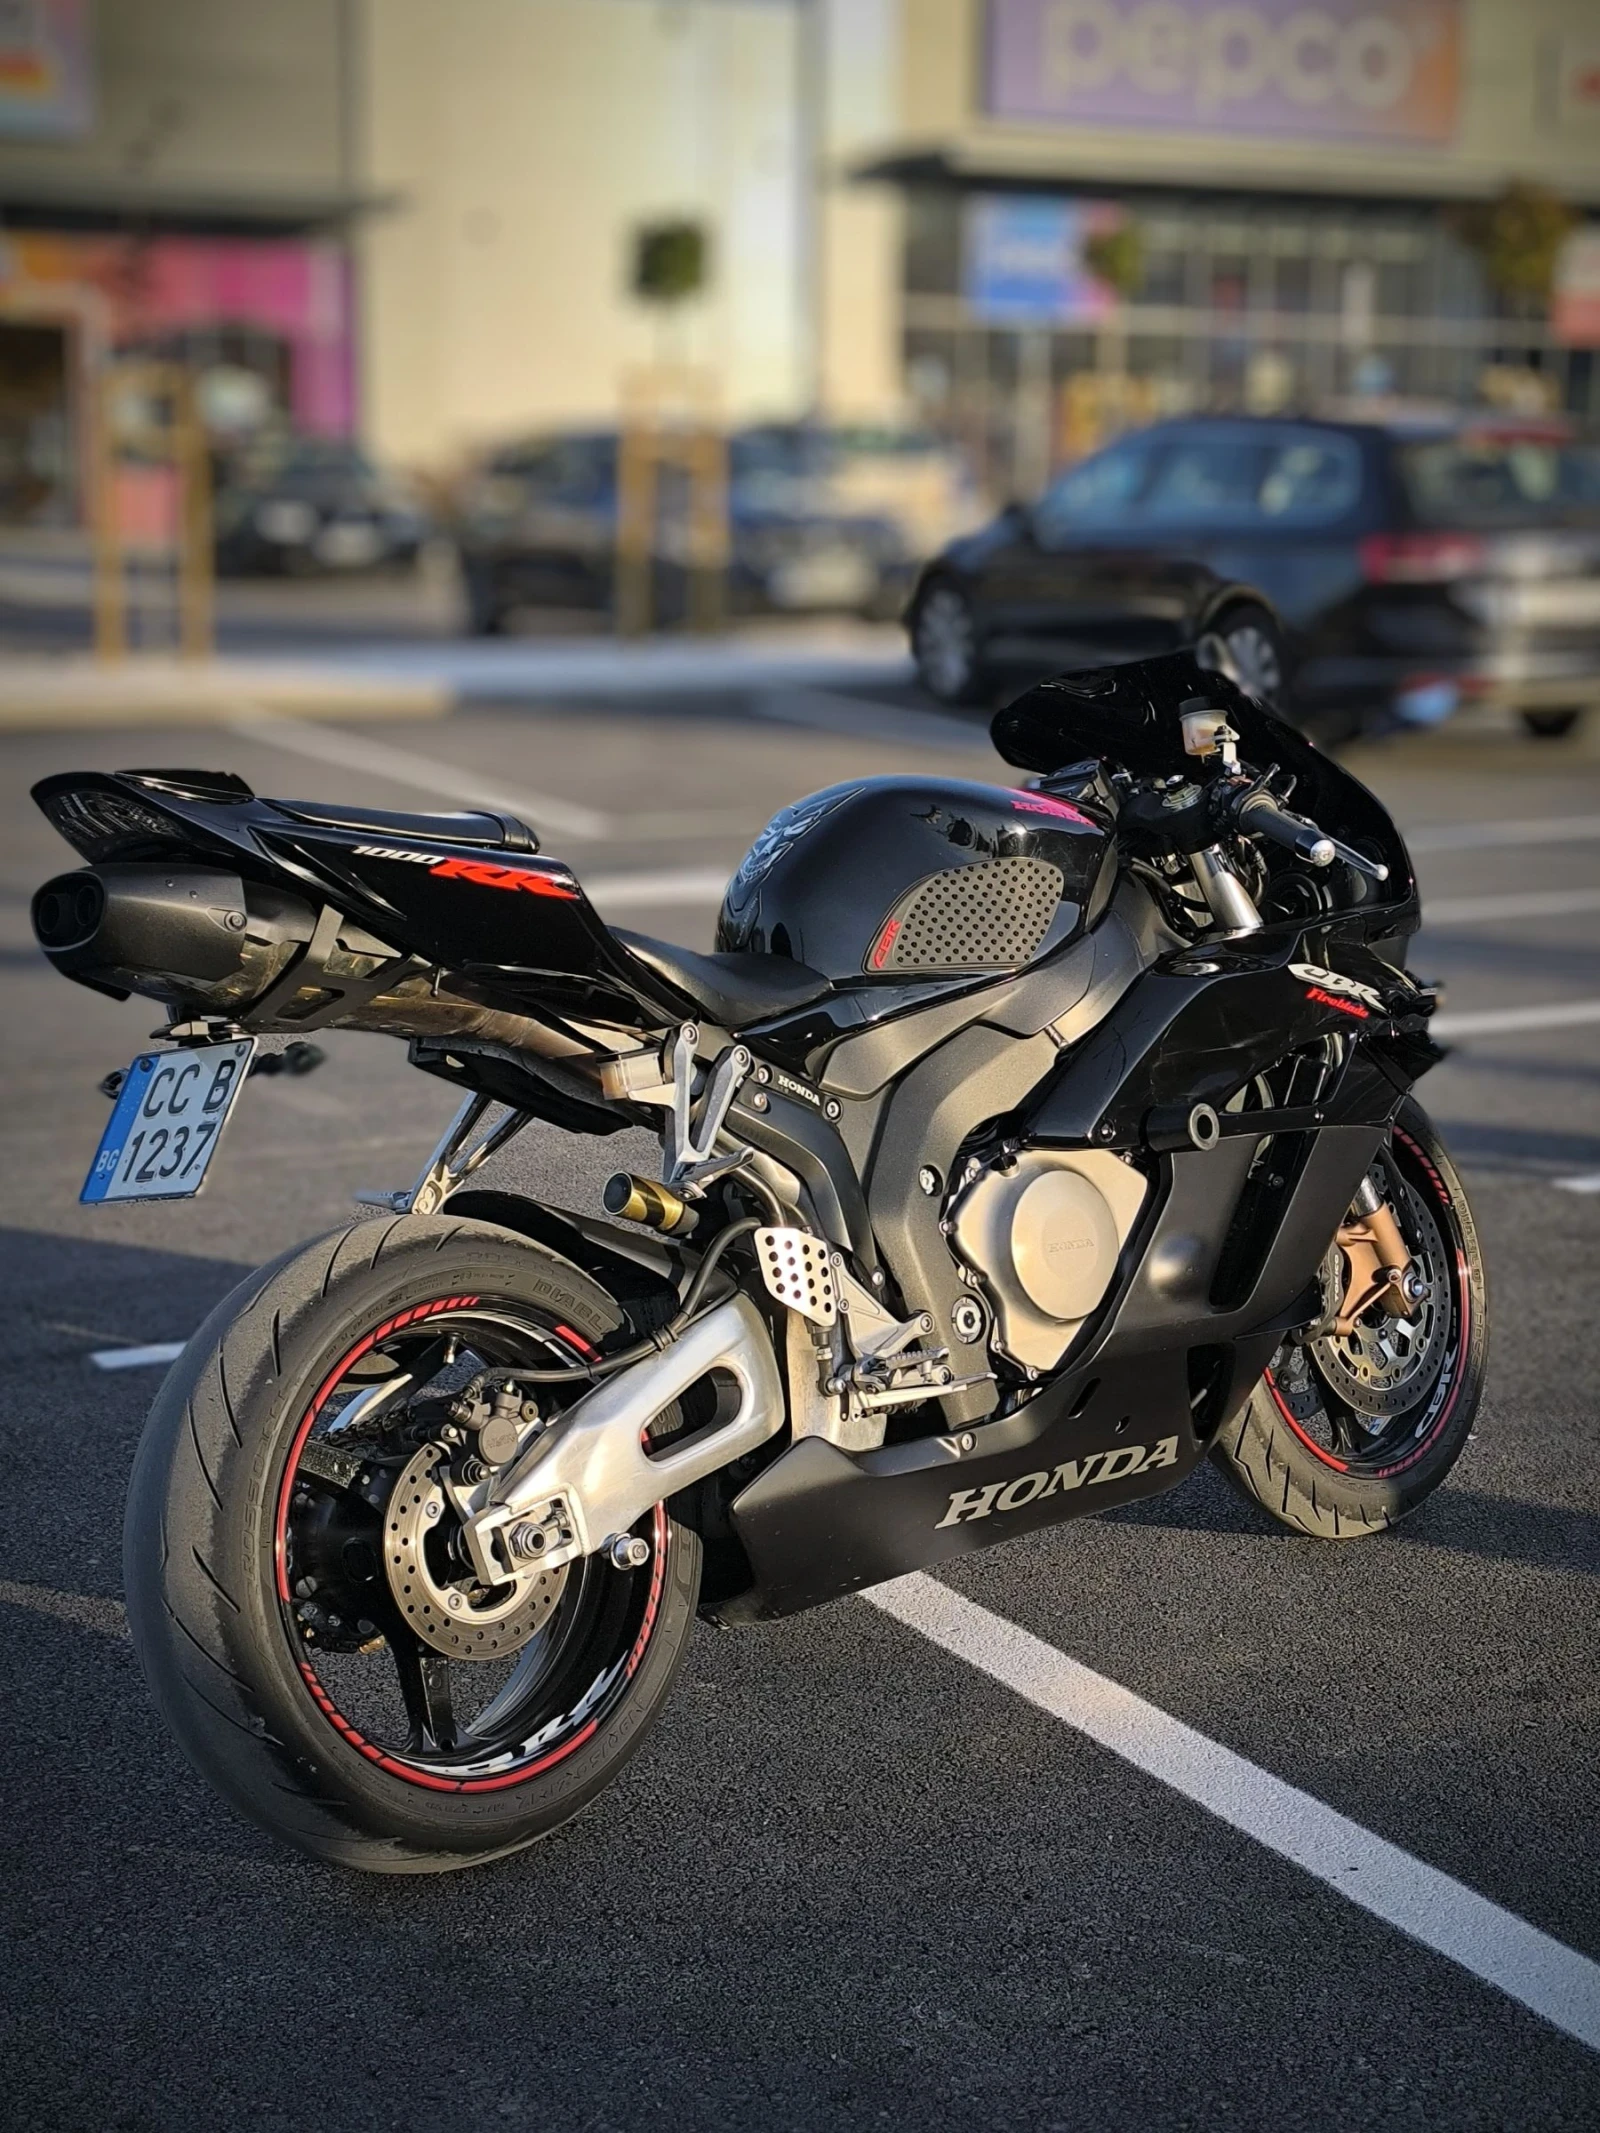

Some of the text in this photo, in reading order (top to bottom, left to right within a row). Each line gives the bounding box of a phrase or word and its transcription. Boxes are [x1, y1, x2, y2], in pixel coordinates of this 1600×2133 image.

[1038, 3, 1413, 118] pepco
[1288, 963, 1389, 1013] CBR
[1306, 987, 1369, 1018] Fireblade
[143, 1059, 236, 1118] CC B
[777, 1074, 821, 1107] HONDA
[95, 1149, 120, 1172] BG
[122, 1122, 216, 1182] 1237
[533, 1278, 603, 1332] DIABL
[1415, 1342, 1458, 1439] CBR
[934, 1435, 1179, 1530] HONDA
